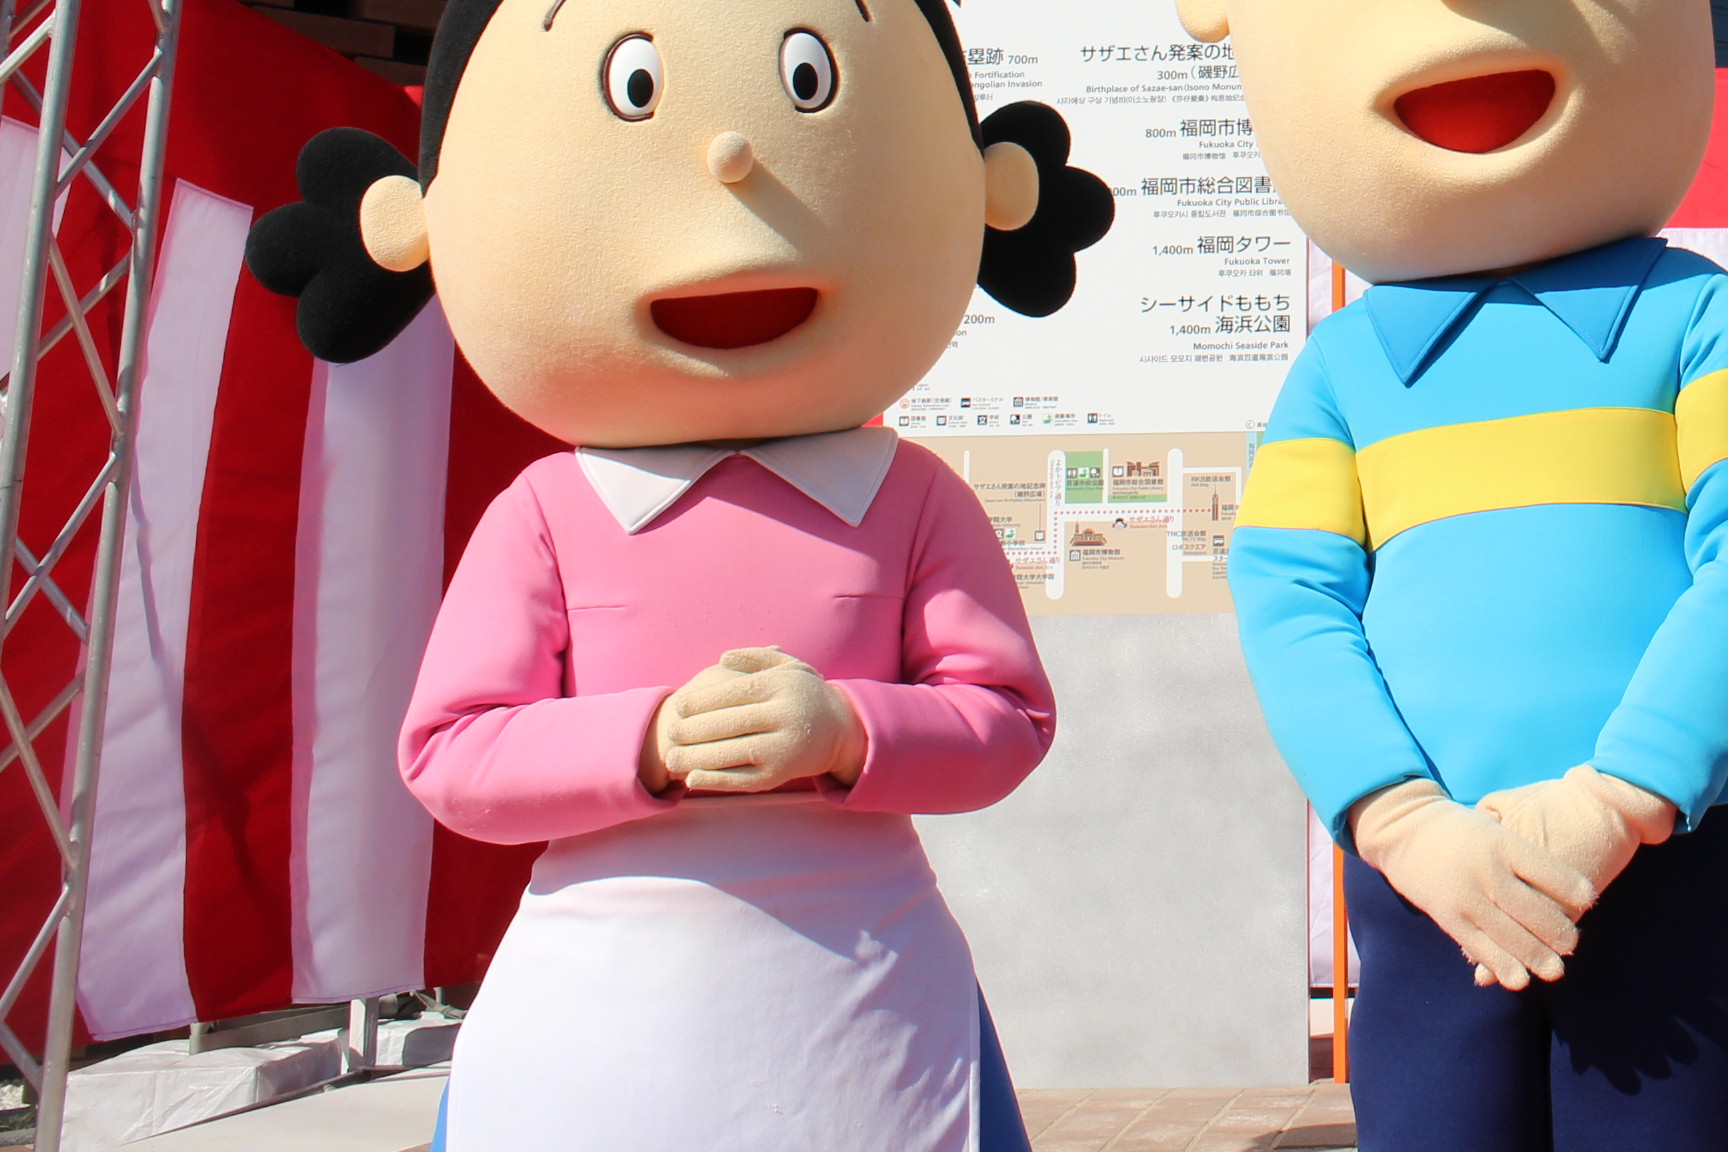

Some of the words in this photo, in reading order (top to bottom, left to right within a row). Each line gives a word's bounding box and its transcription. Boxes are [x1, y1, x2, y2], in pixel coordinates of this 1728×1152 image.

[1008, 54, 1039, 65] 700m
[974, 70, 1025, 79] Fortification
[1157, 70, 1188, 80] 300m
[970, 80, 1006, 89] ongolian
[1007, 79, 1043, 88] Invasion
[1086, 85, 1128, 93] Birthplace
[1130, 84, 1139, 92] of
[1145, 128, 1177, 139] 800m
[1180, 117, 1254, 137] 福岡市博
[1199, 140, 1235, 149] Fukuoka
[1237, 139, 1254, 150] City
[1140, 175, 1277, 196] 福岡市総合図書
[1177, 199, 1213, 207] Fukuoka
[1215, 198, 1232, 208] City
[1234, 197, 1260, 206] Public
[1152, 244, 1194, 256] 1,400m
[1197, 235, 1291, 254] 福岡タワー
[1224, 257, 1261, 266] Fukuoka
[1262, 257, 1290, 266] Tower
[1140, 294, 1291, 313] シーサイドももち
[1169, 324, 1211, 336] 1,400m
[1215, 314, 1291, 334] 海浜公園
[1193, 341, 1233, 351] Momochi
[1235, 341, 1268, 350] Seaside
[1270, 340, 1289, 349] Park
